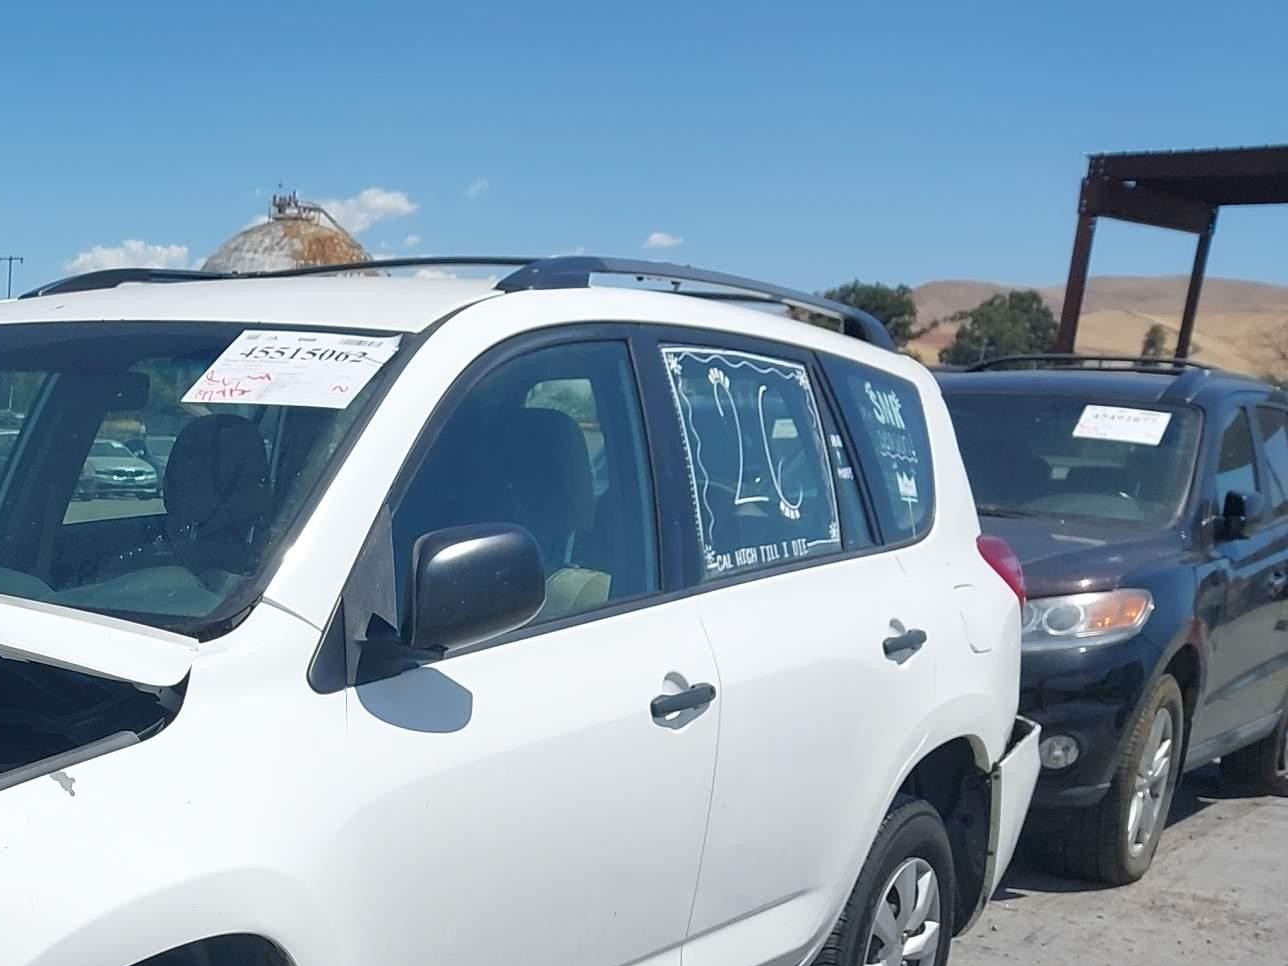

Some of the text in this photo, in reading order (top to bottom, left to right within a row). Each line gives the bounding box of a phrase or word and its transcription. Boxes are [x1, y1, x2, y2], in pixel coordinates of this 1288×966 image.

[240, 345, 368, 363] 45515062
[716, 554, 735, 572] CAL
[734, 547, 758, 566] HIGH
[759, 543, 780, 563] TILL
[792, 538, 808, 556] DIE
